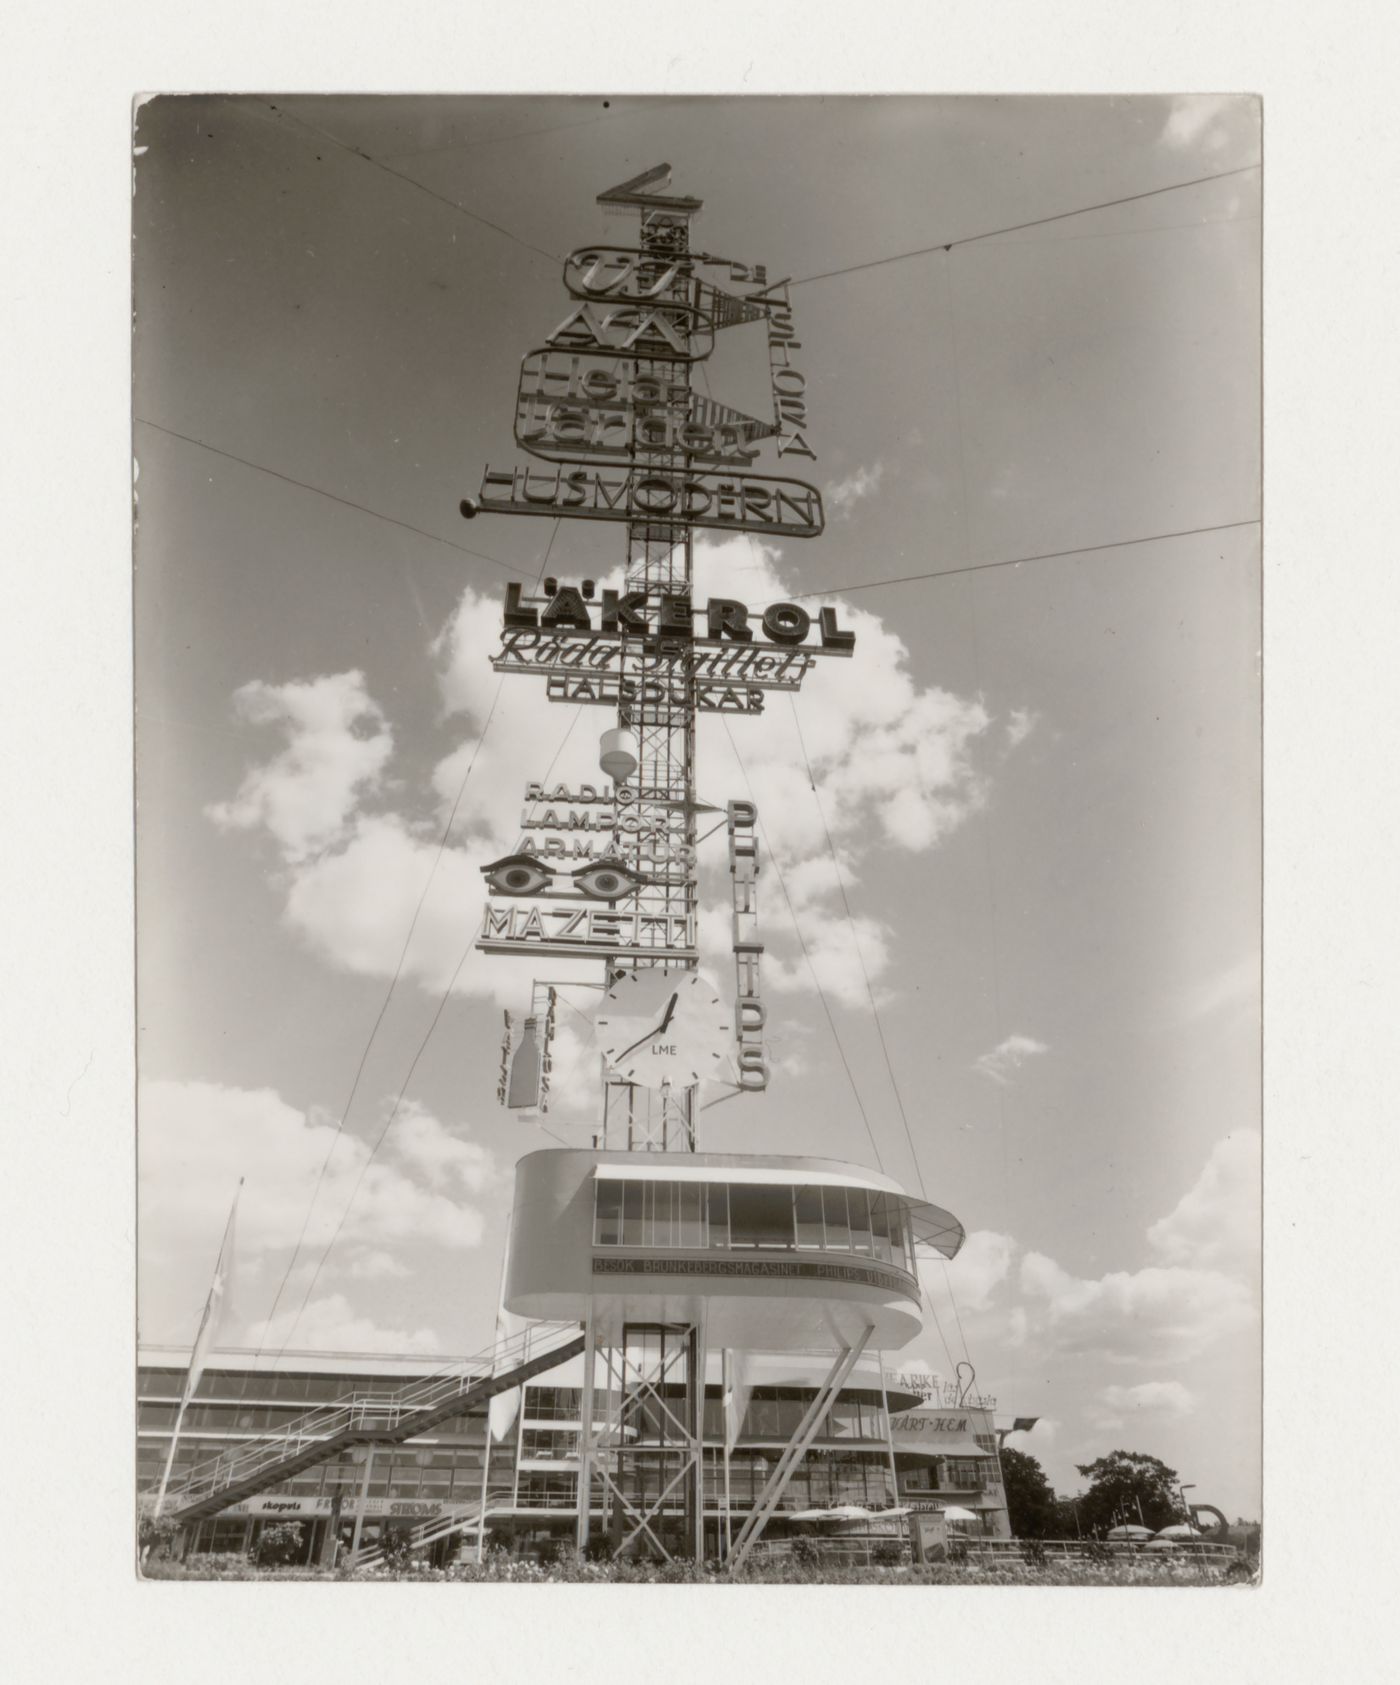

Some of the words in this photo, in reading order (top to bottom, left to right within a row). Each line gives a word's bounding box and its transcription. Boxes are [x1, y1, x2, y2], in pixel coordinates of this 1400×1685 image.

[478, 464, 816, 527] HUSMODERN
[503, 576, 856, 650] LÄKEROL
[488, 626, 622, 671] Röda
[546, 674, 766, 713] HALSDUKAR
[524, 781, 638, 806] RADIO
[520, 807, 672, 834] LAMPOR
[480, 902, 697, 950] MAZETTI
[727, 799, 771, 1093] PHILIPS
[651, 1044, 678, 1057] LME
[934, 1416, 969, 1432] HEM
